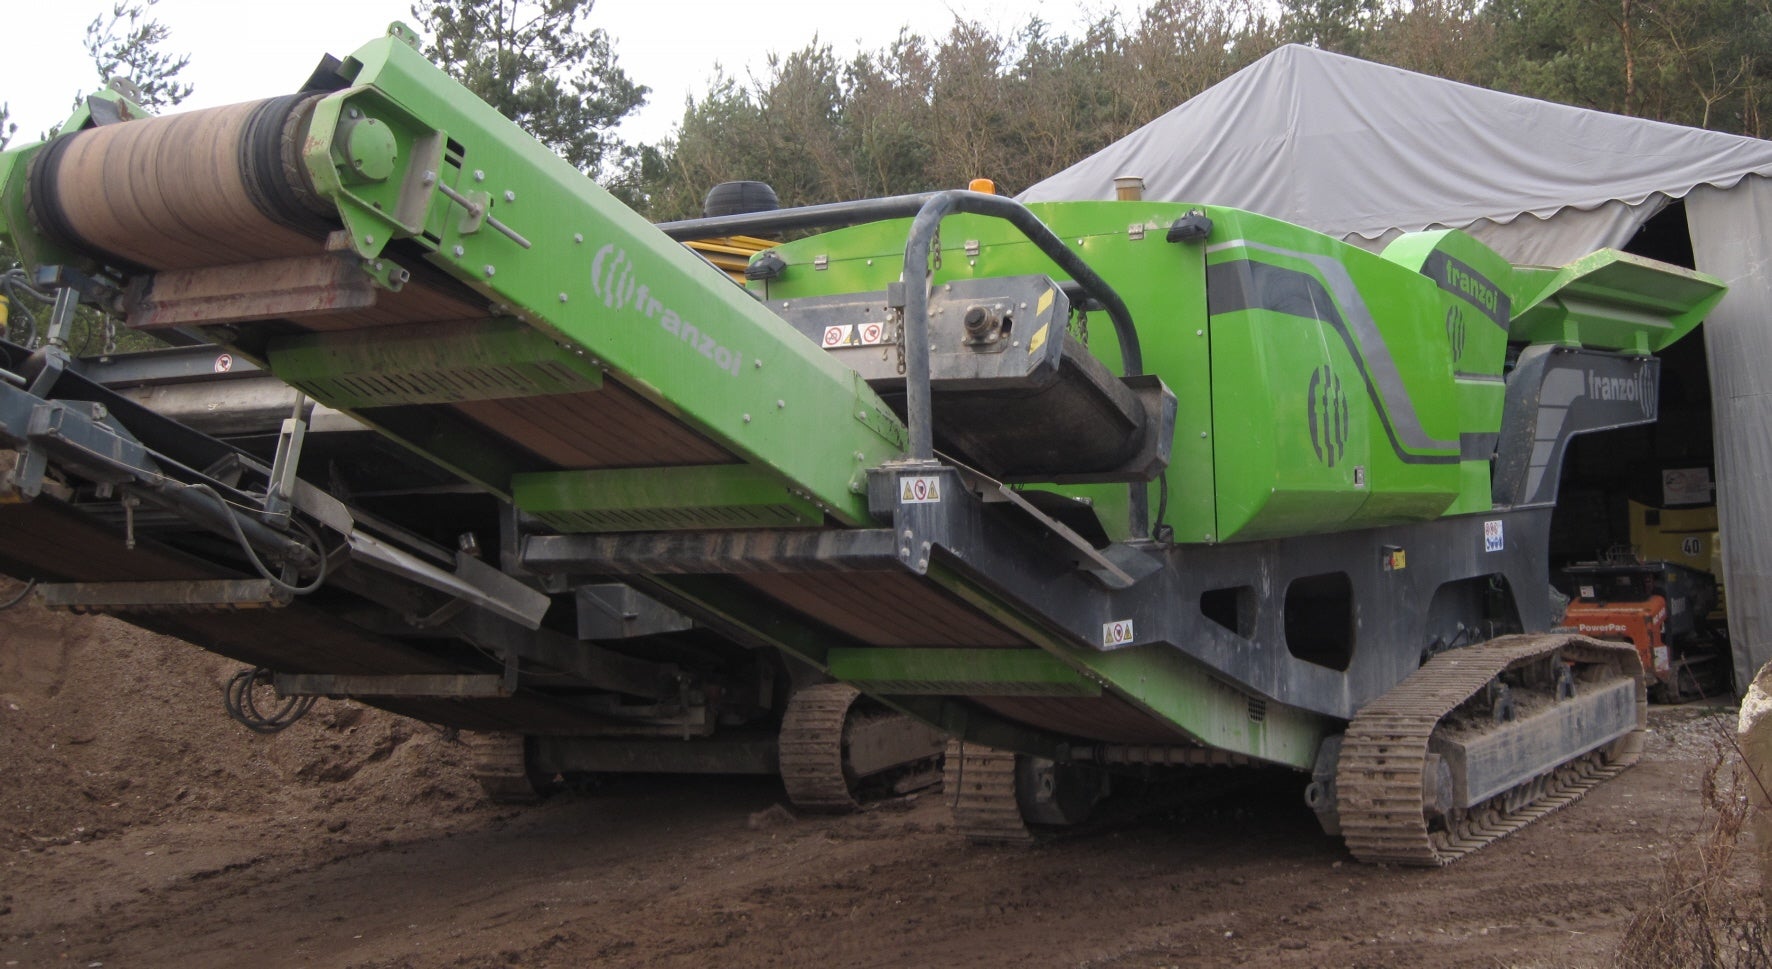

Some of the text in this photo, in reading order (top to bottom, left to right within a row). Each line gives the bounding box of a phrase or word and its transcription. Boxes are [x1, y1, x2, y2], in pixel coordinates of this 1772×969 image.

[1446, 260, 1498, 313] franzoi
[1588, 369, 1639, 401] franzoi
[1684, 539, 1700, 554] 40
[1579, 623, 1627, 632] PowerPac
